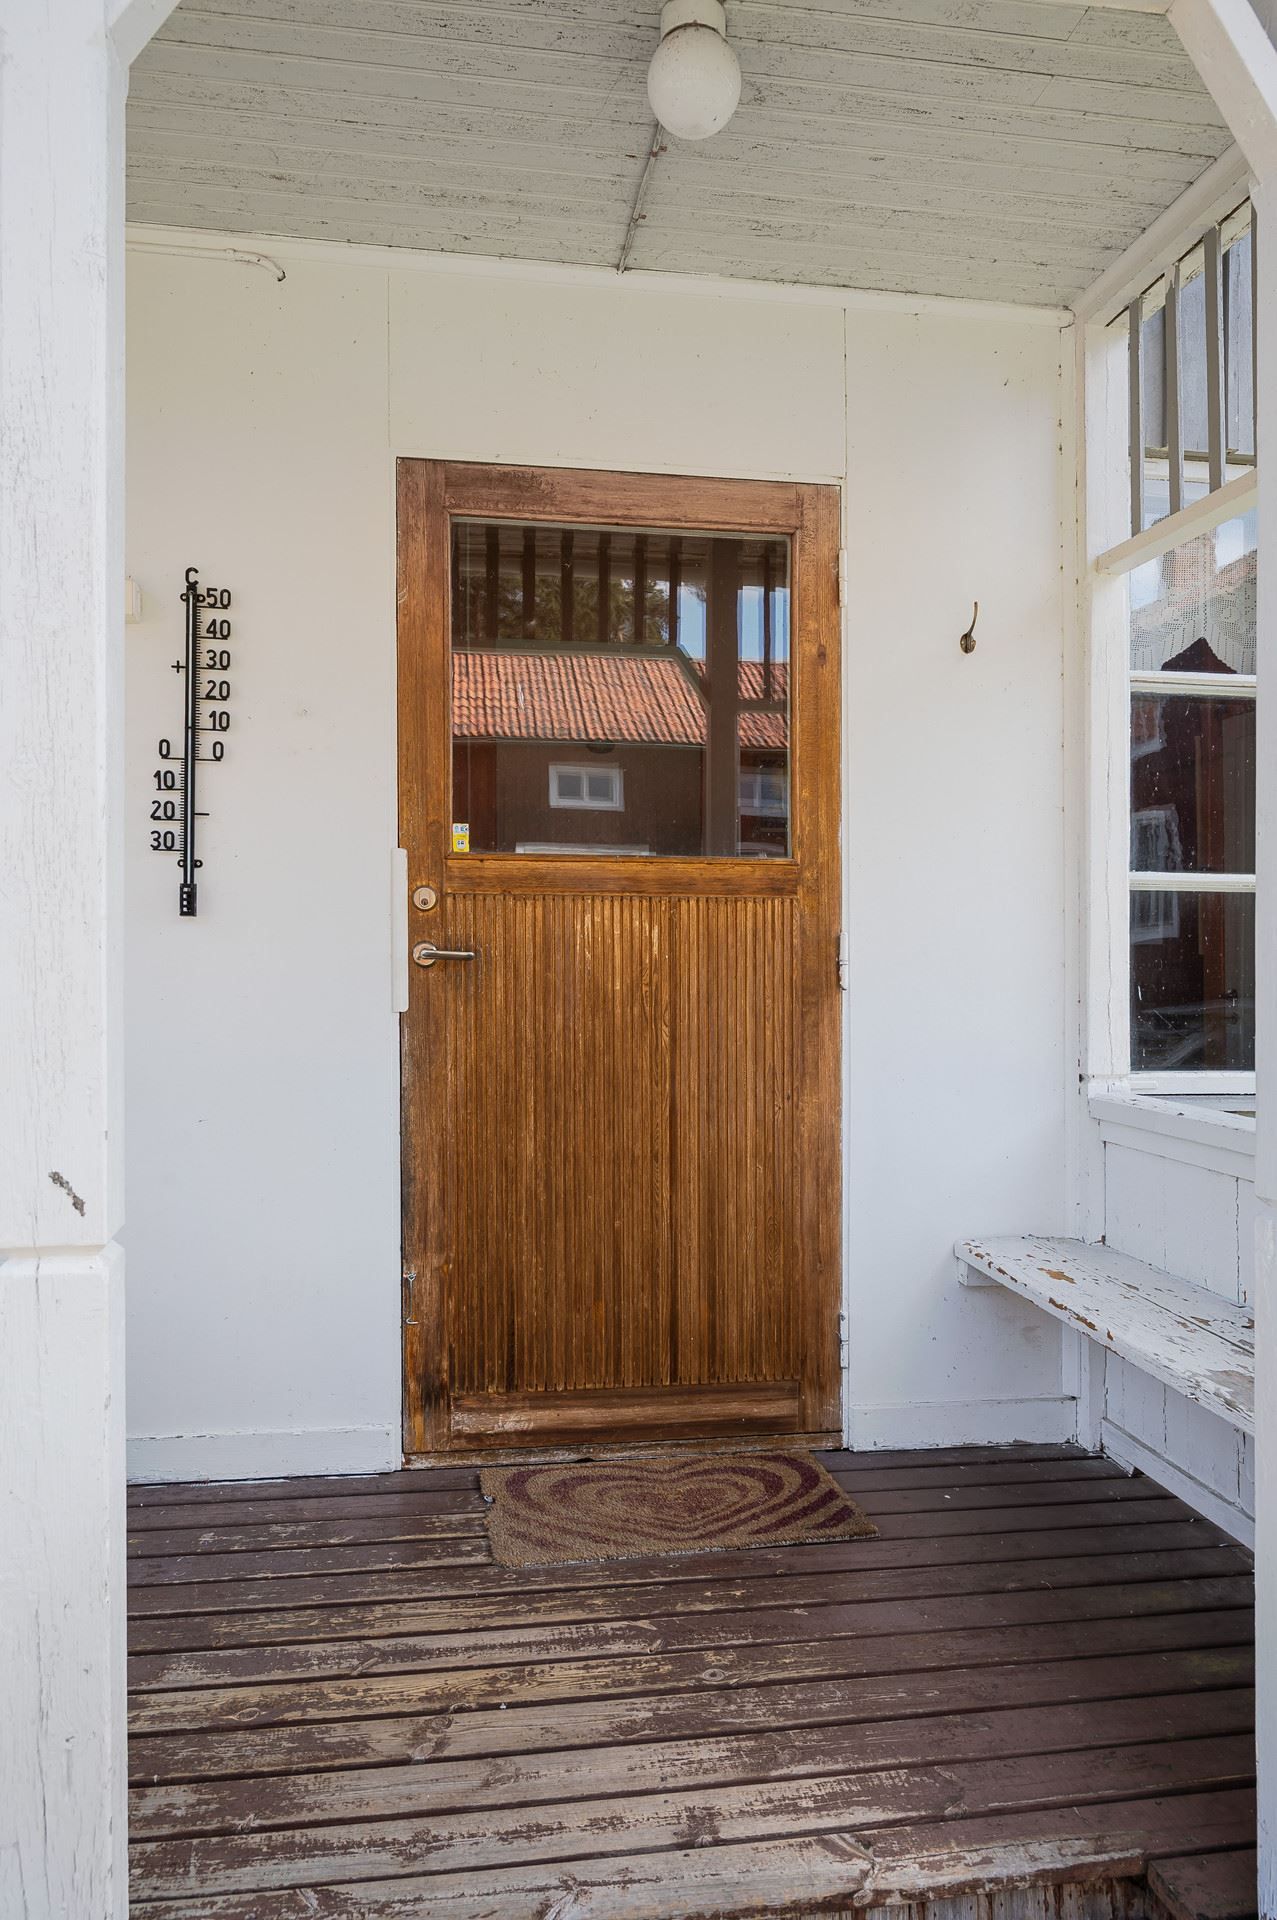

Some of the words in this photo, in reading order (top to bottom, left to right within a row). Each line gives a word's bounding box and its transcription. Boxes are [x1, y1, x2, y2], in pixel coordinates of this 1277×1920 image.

[185, 567, 200, 586] C
[206, 588, 232, 608] 50
[205, 619, 231, 639] 40
[206, 650, 231, 669] 30
[205, 680, 231, 699] 20
[208, 710, 231, 730] 10
[158, 739, 171, 758] 0
[212, 741, 225, 760] 0
[153, 770, 175, 789] 10
[150, 800, 176, 820] 20
[150, 831, 175, 850] 30
